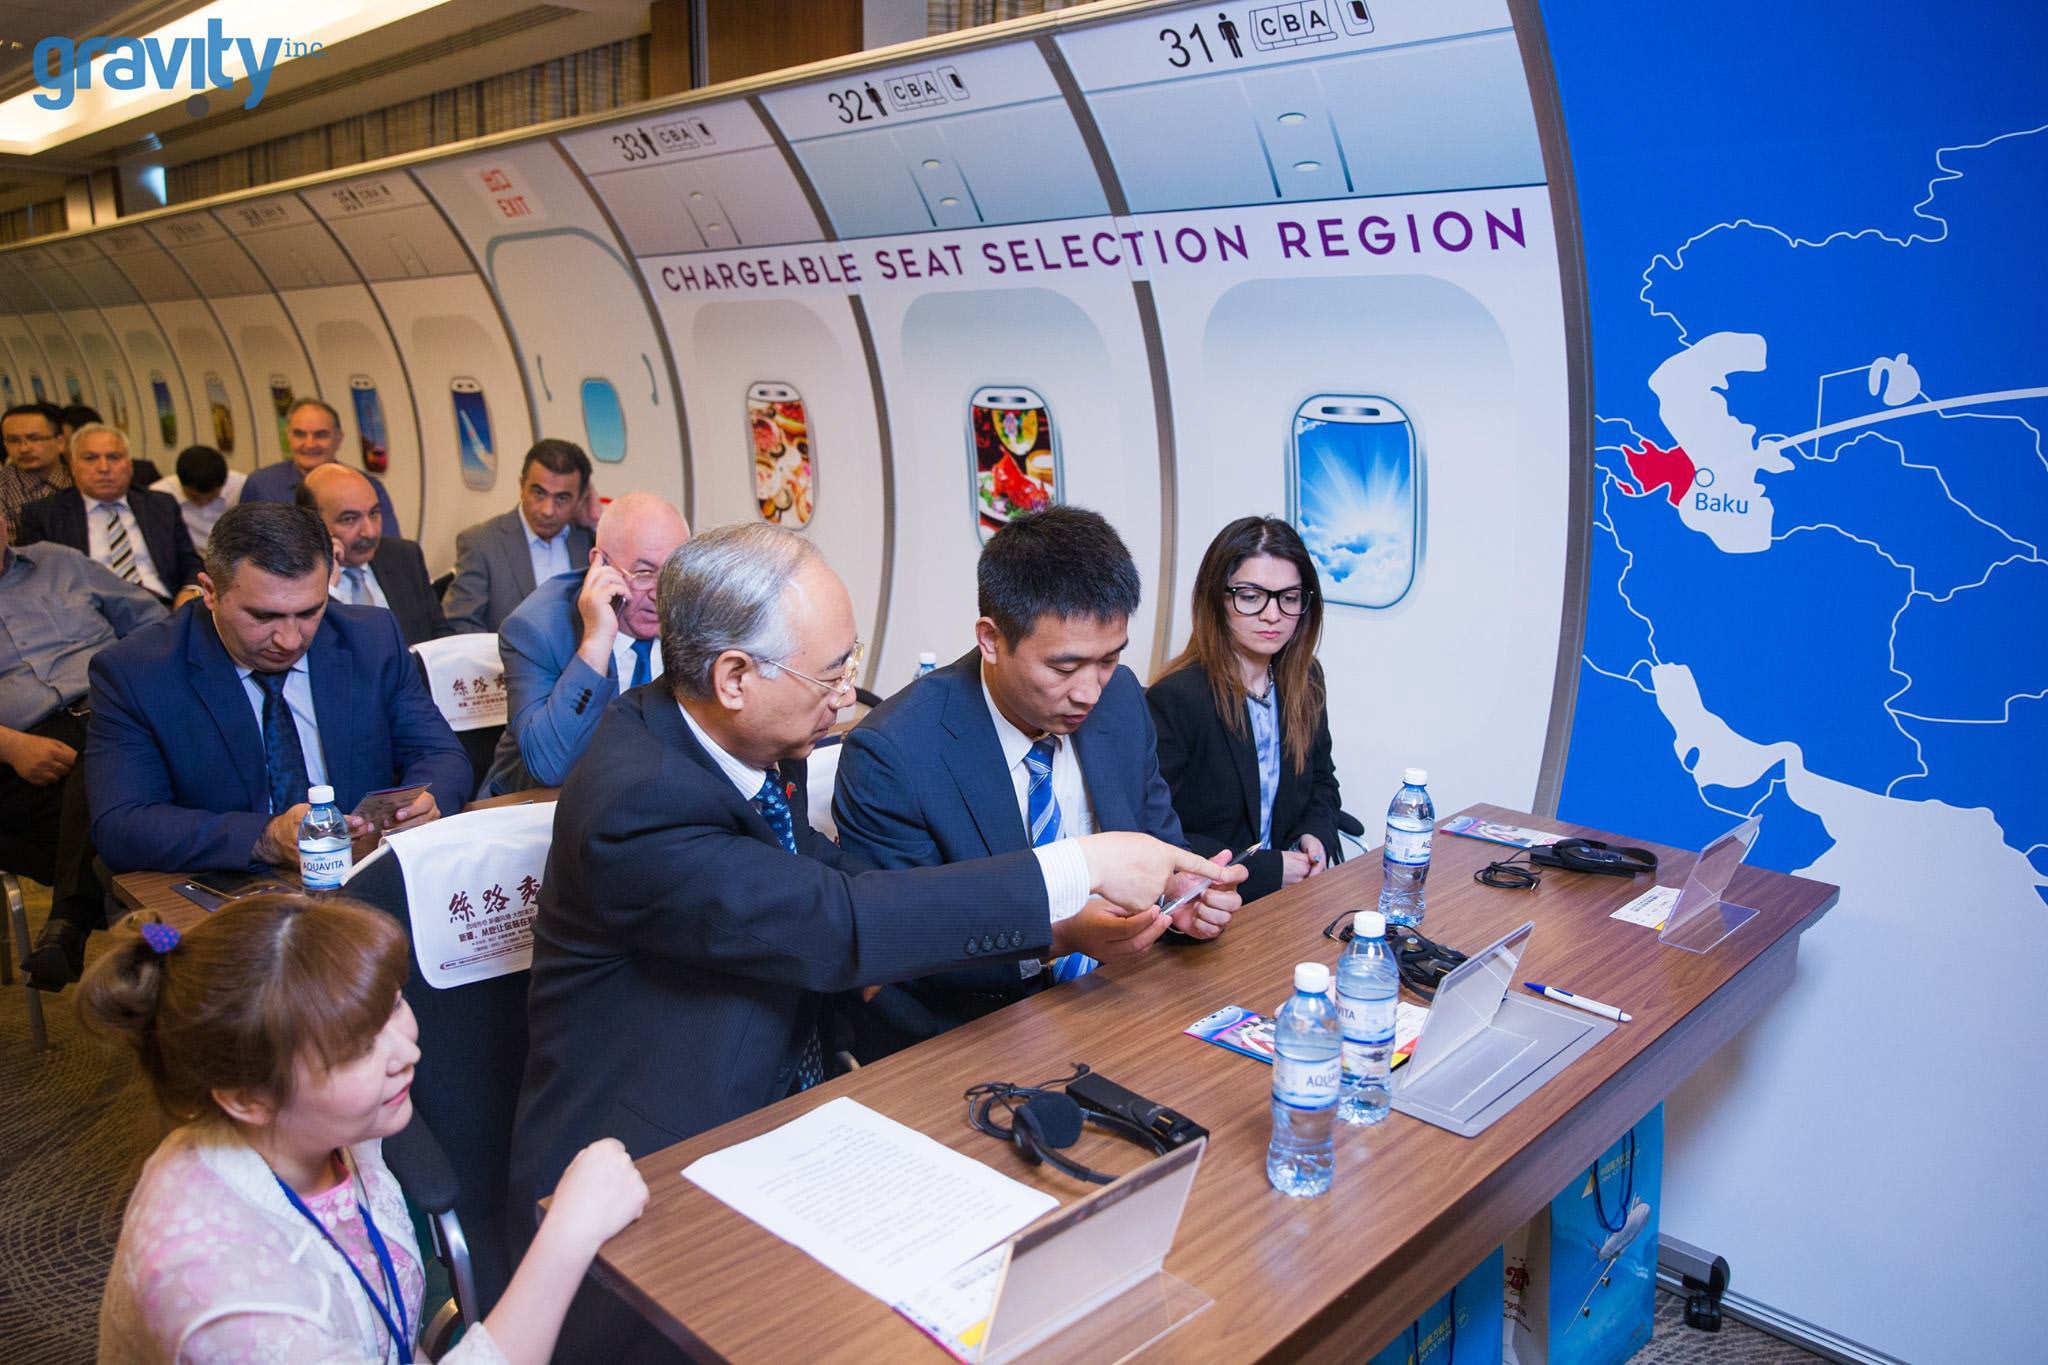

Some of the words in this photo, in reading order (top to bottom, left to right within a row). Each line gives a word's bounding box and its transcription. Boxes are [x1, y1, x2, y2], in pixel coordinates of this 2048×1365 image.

[1159, 22, 1214, 68] 31
[828, 89, 873, 124] 32
[612, 131, 649, 162] 33
[497, 196, 532, 218] EXIT
[661, 252, 862, 292] CHARGEABLE
[875, 243, 964, 281] SEAT
[982, 224, 1249, 275] SELECTION
[1277, 207, 1527, 260] REGION
[1695, 492, 1749, 515] Baku
[303, 859, 345, 872] AQUAVITA
